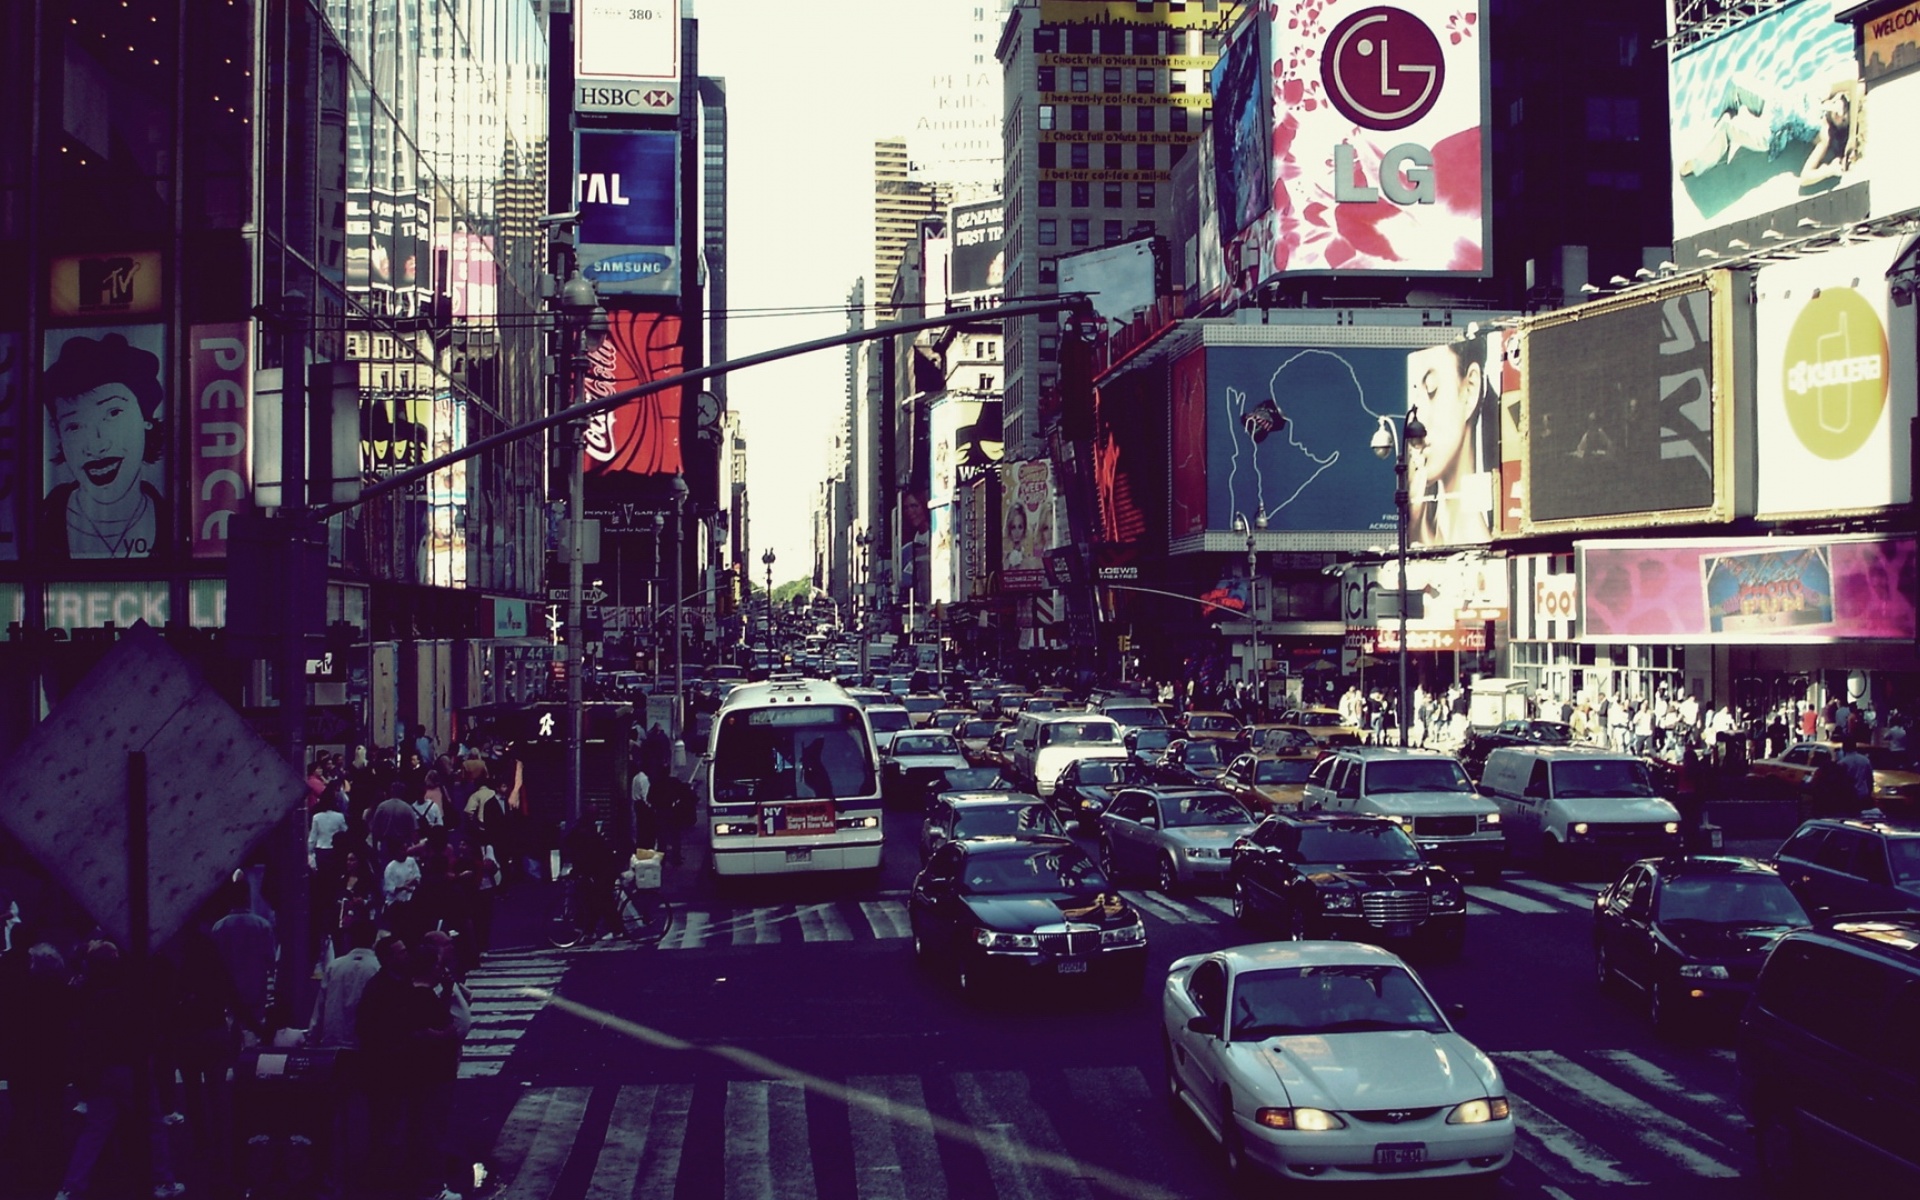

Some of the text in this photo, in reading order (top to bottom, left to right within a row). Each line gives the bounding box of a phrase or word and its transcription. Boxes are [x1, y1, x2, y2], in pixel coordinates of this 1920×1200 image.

[629, 9, 652, 20] 380
[1053, 56, 1083, 65] Chock
[1087, 56, 1102, 65] full
[1151, 57, 1171, 67] that
[581, 88, 640, 106] HSBC
[1053, 132, 1083, 142] Chock
[1087, 132, 1102, 142] full
[1151, 133, 1171, 142] that
[1334, 143, 1436, 205] LG
[594, 262, 661, 273] SAMSUNG
[1099, 567, 1138, 575] LOEWS
[584, 591, 601, 599] WAY
[527, 648, 544, 660] 44
[763, 807, 782, 816] NY
[764, 817, 774, 834] 1
